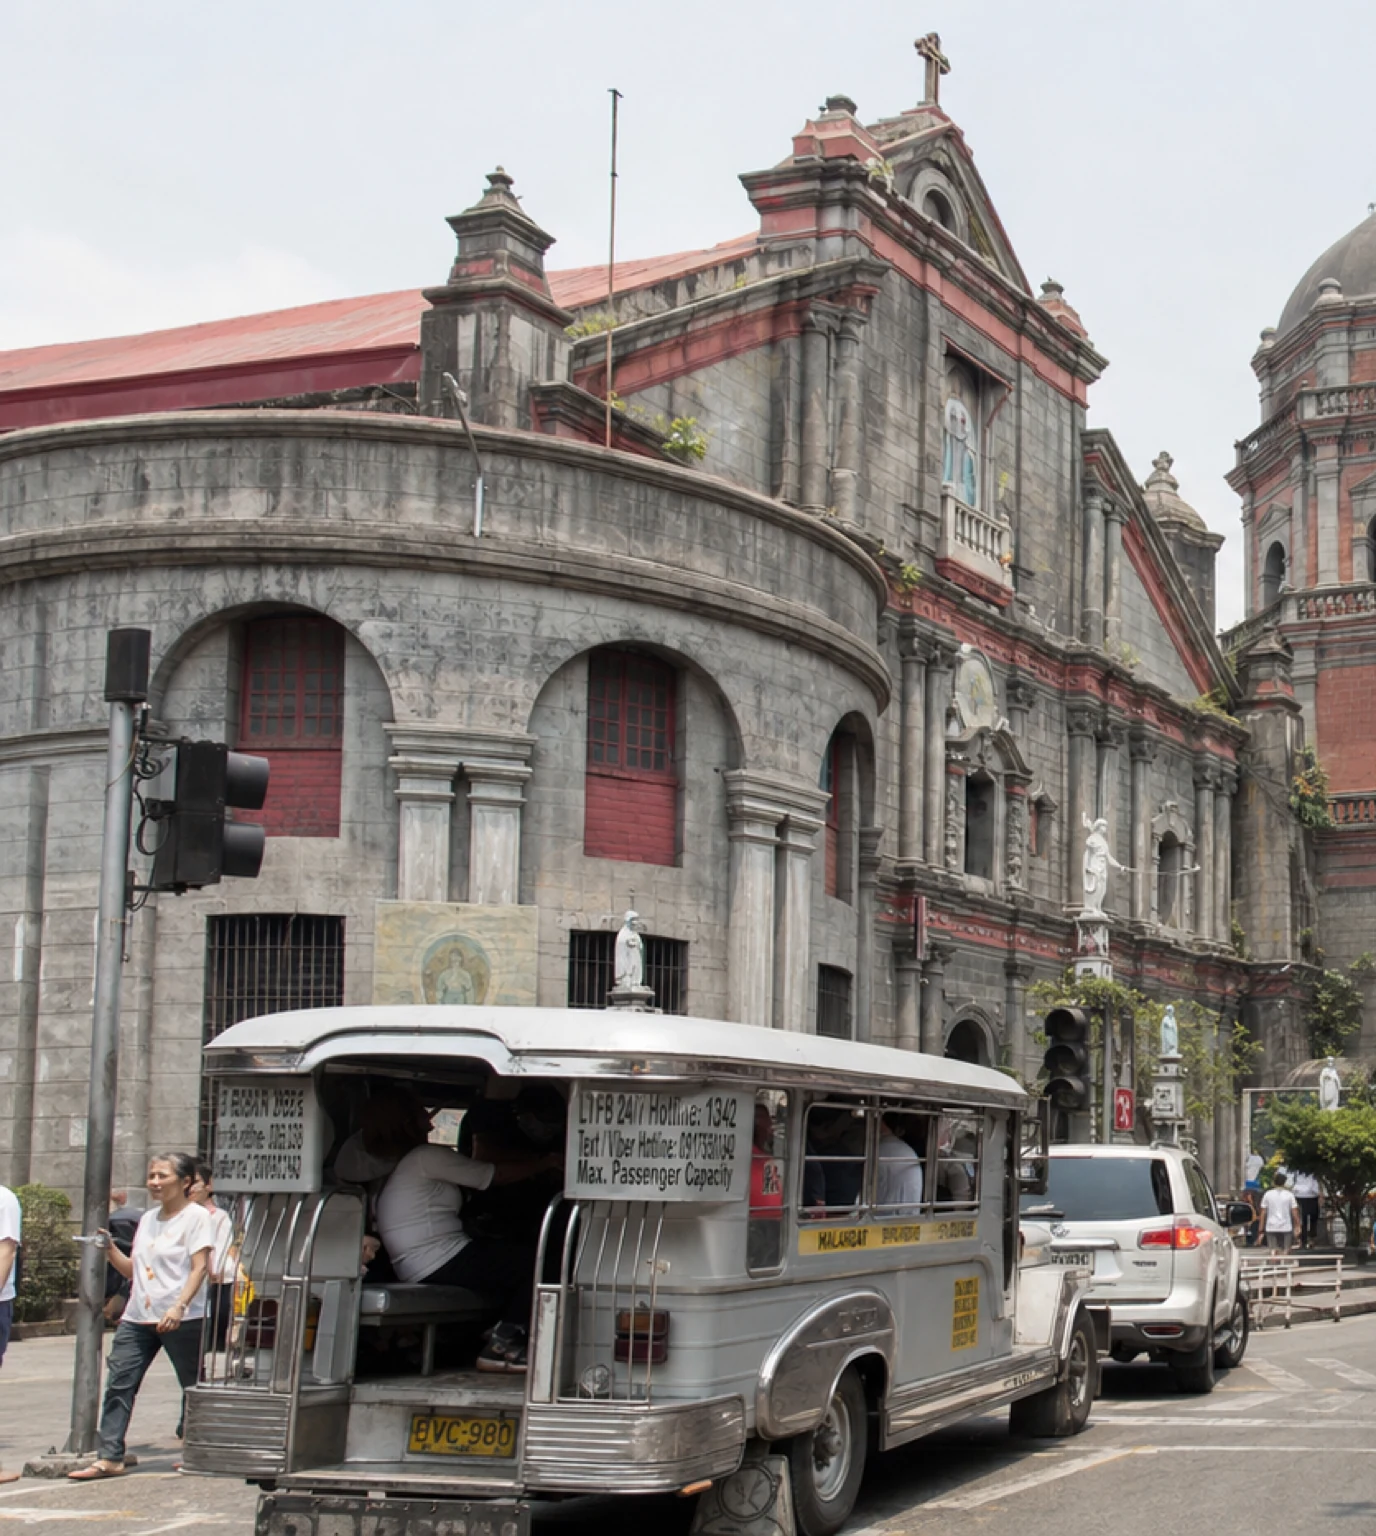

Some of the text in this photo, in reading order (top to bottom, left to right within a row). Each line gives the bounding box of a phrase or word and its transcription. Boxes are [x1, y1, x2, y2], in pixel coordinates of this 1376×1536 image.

[705, 1097, 737, 1129] 1342
[576, 1159, 608, 1185] Max.
[611, 1159, 682, 1191] Passenger
[684, 1161, 734, 1192] Capacity
